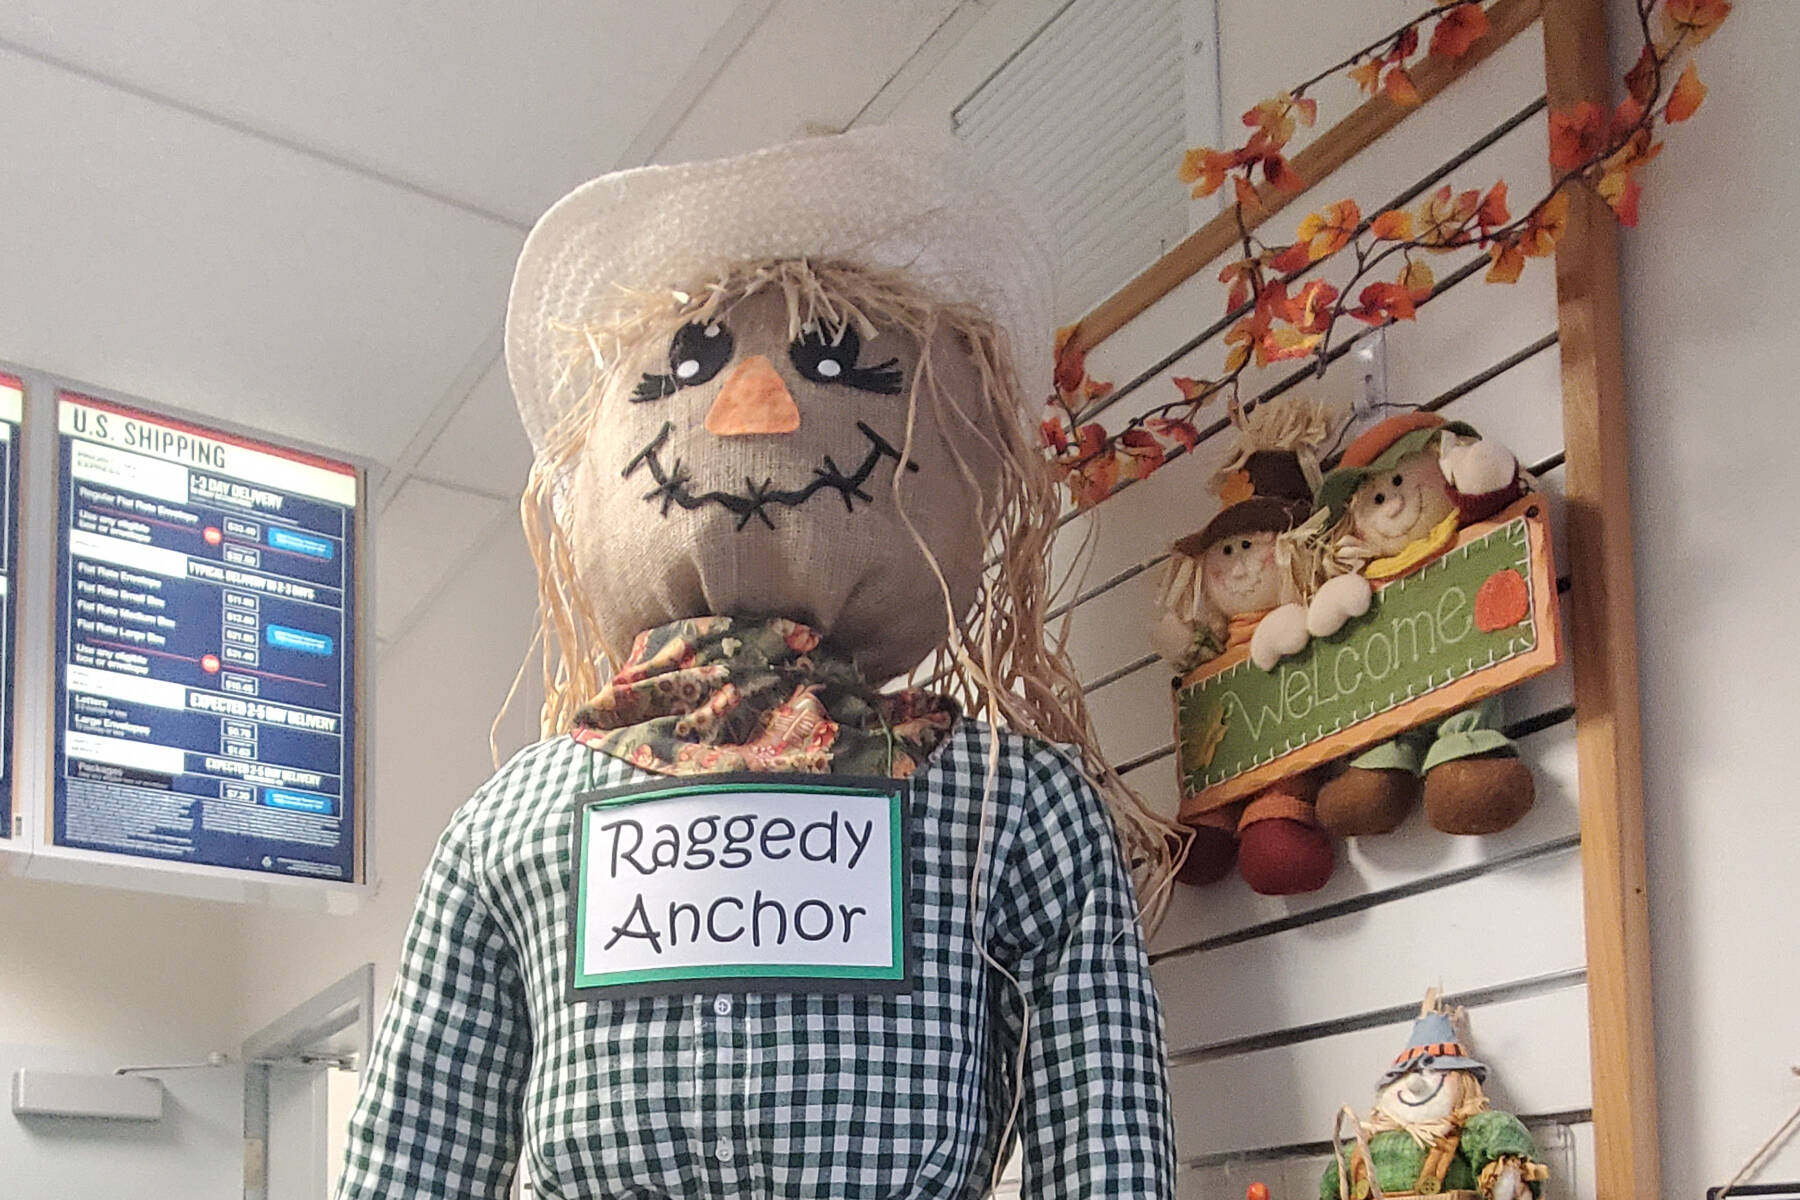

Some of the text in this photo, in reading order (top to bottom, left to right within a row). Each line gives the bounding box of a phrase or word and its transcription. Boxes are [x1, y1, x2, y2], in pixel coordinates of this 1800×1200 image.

[73, 407, 225, 468] U.S. SHIPPING
[79, 486, 116, 504] Regular
[116, 494, 134, 507] Flat
[135, 499, 157, 513] Rate
[157, 505, 199, 523] Envelope
[208, 477, 231, 498] DAY
[231, 483, 284, 510] DELIVERY
[77, 561, 162, 589] Flat Rate Envelope
[188, 561, 224, 580] TYPICAL
[225, 570, 267, 589] DELIVERY
[77, 579, 166, 608] Flat Rate Small Box
[77, 598, 176, 628] Flat Rate Medium Box
[76, 617, 166, 645] Flat Rate Large Box
[75, 693, 110, 709] Letters
[190, 692, 337, 731] EXPECTED 2-5 DAY DELIVERY
[75, 714, 103, 730] Large
[103, 718, 151, 737] Envelopes
[78, 761, 124, 777] Packages
[205, 757, 250, 776] EXPECTED
[249, 764, 265, 778] 2-5
[264, 766, 282, 780] DAY
[281, 770, 322, 788] DELIVERY
[601, 811, 873, 878] Raggedy
[604, 889, 867, 954] Anchor
